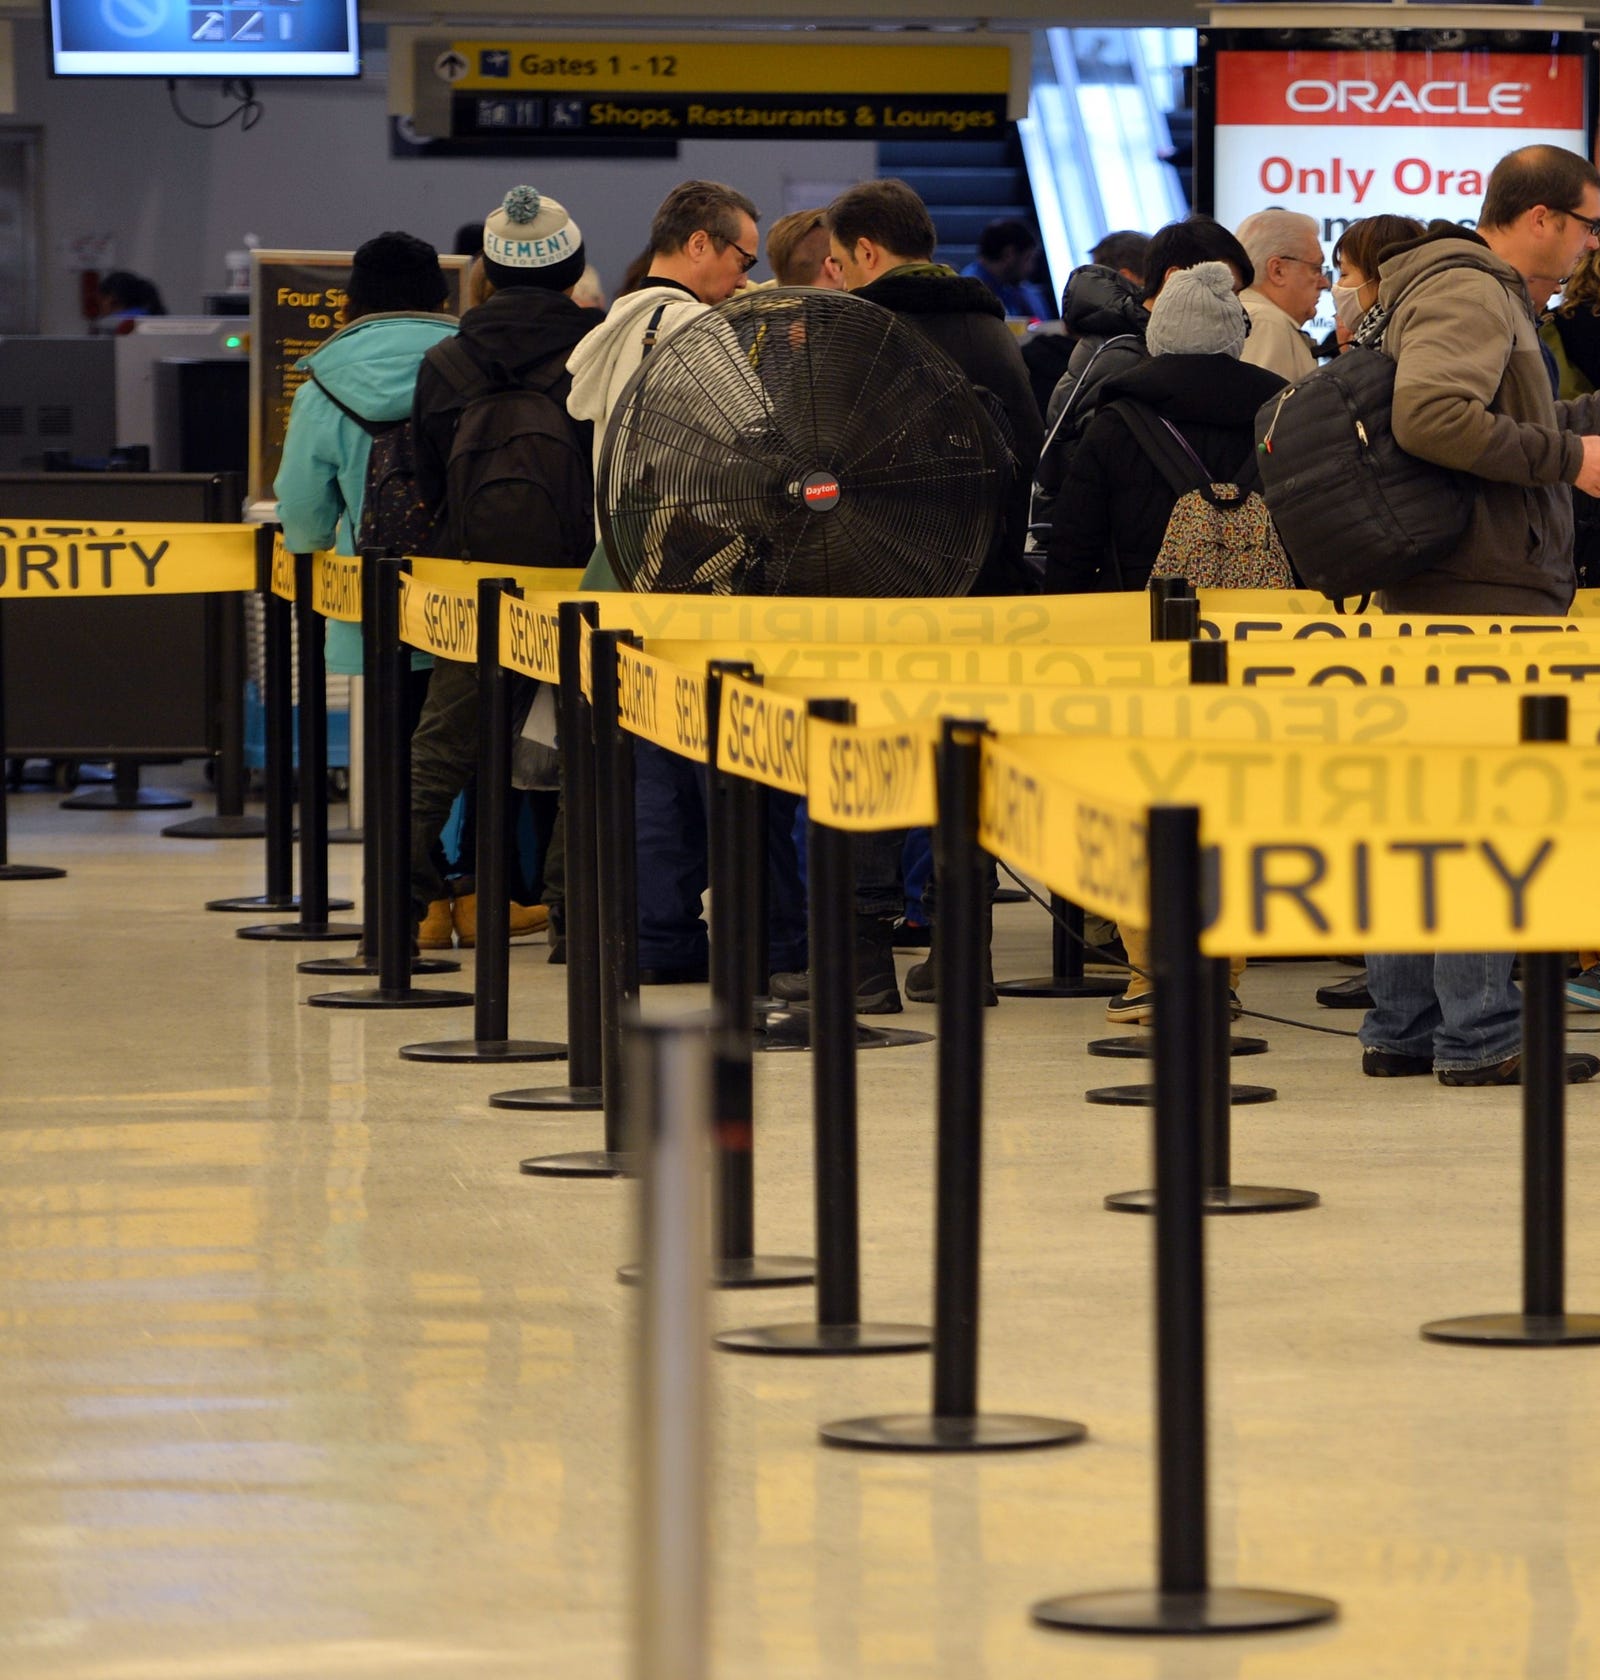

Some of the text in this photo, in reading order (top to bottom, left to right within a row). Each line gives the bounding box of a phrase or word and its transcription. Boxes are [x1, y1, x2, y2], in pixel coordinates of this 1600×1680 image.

[519, 55, 597, 76] Gates
[607, 56, 620, 76] 1
[650, 56, 677, 76] 12
[590, 103, 996, 131] Shops, Restaurants & Lounges
[1260, 156, 1490, 204] Only Ora
[487, 230, 570, 258] ELEMENT
[277, 287, 322, 307] Four
[308, 312, 331, 329] to
[805, 484, 837, 496] Dayton
